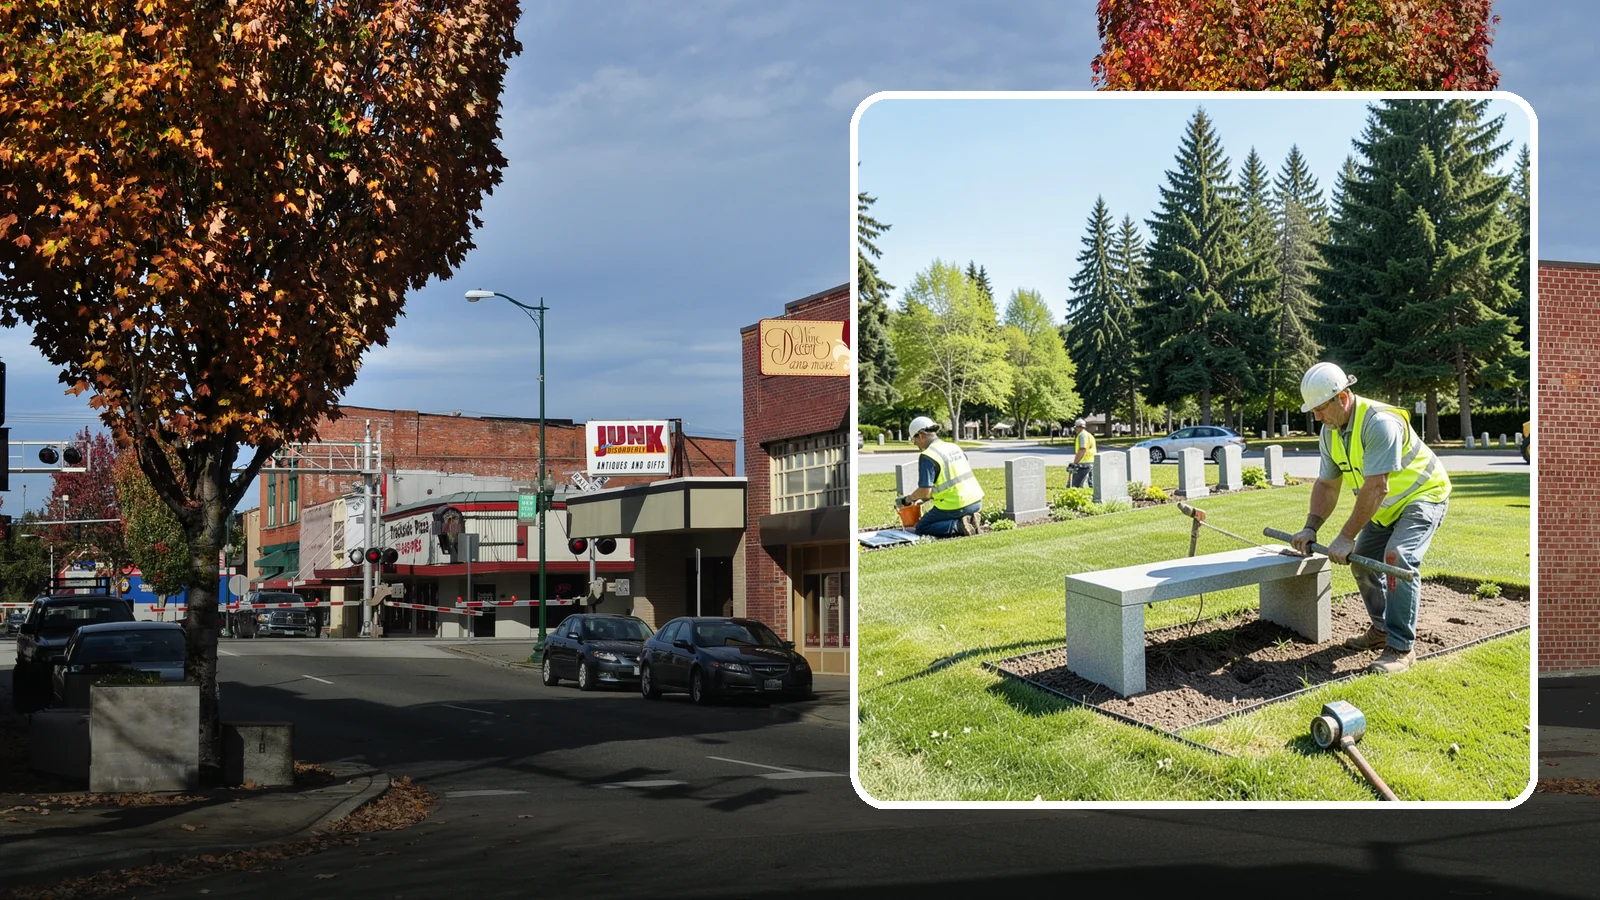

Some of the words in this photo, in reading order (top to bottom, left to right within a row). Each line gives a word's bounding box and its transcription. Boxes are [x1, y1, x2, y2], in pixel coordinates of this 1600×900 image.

[596, 425, 666, 457] JUNK
[607, 446, 646, 454] DISORDERLY
[597, 461, 628, 470] ANTIQUES
[631, 461, 643, 470] AND
[647, 461, 665, 469] GIFTS
[390, 521, 413, 539] Trackside
[414, 519, 429, 534] Pizza
